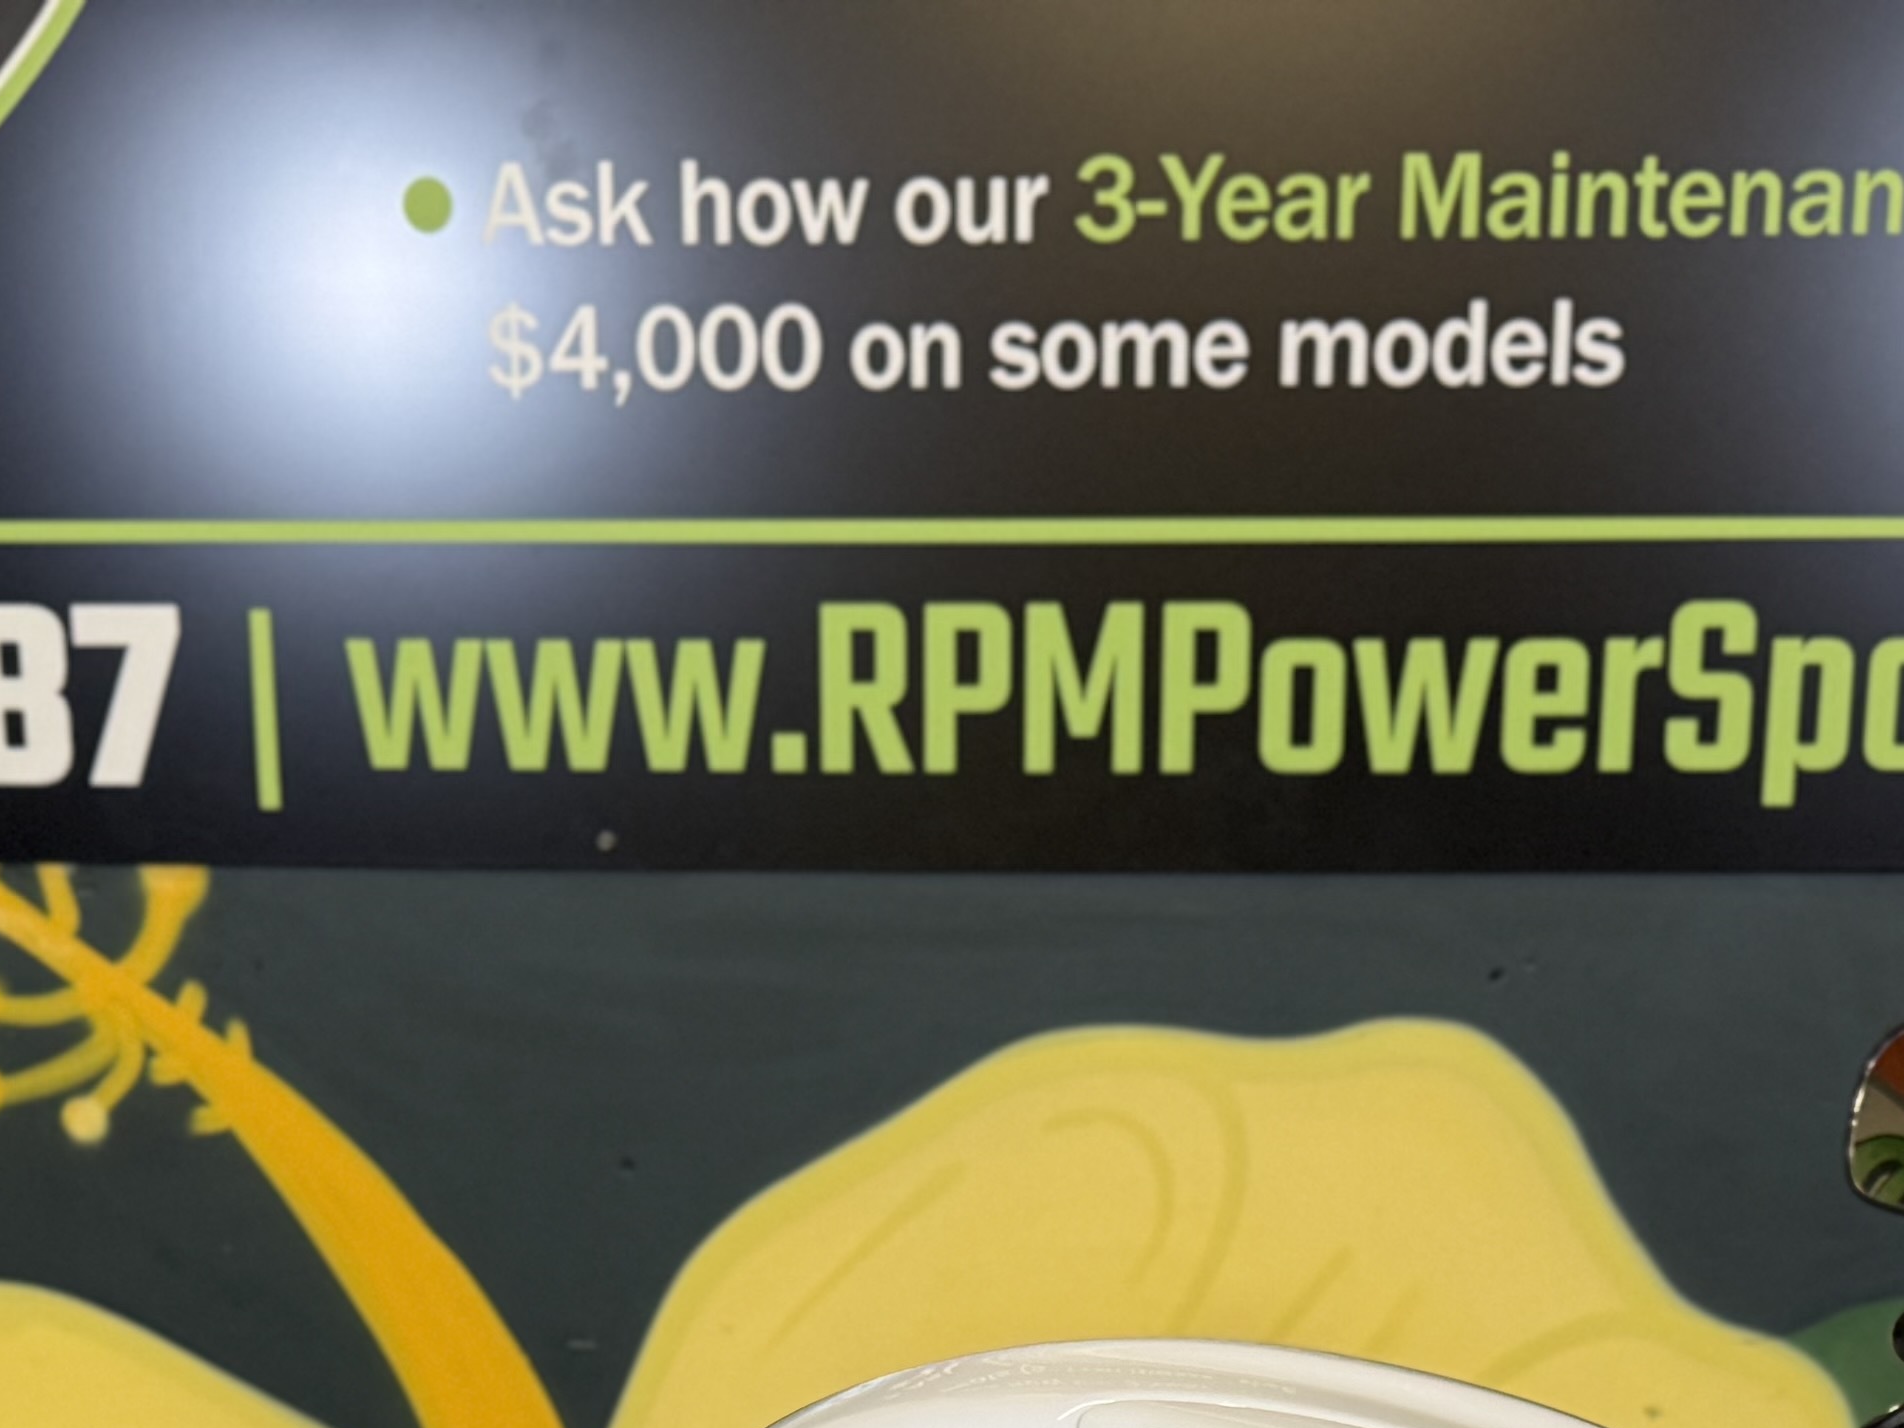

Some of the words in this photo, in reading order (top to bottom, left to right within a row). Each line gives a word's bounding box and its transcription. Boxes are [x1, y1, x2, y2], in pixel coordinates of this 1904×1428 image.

[484, 159, 653, 245] Ask
[680, 159, 868, 245] how
[894, 173, 1048, 246] our
[1074, 152, 1370, 243] 3-Year
[488, 302, 823, 405] $4,000
[849, 322, 961, 390] on
[988, 318, 1249, 390] some
[1279, 298, 1625, 388] models
